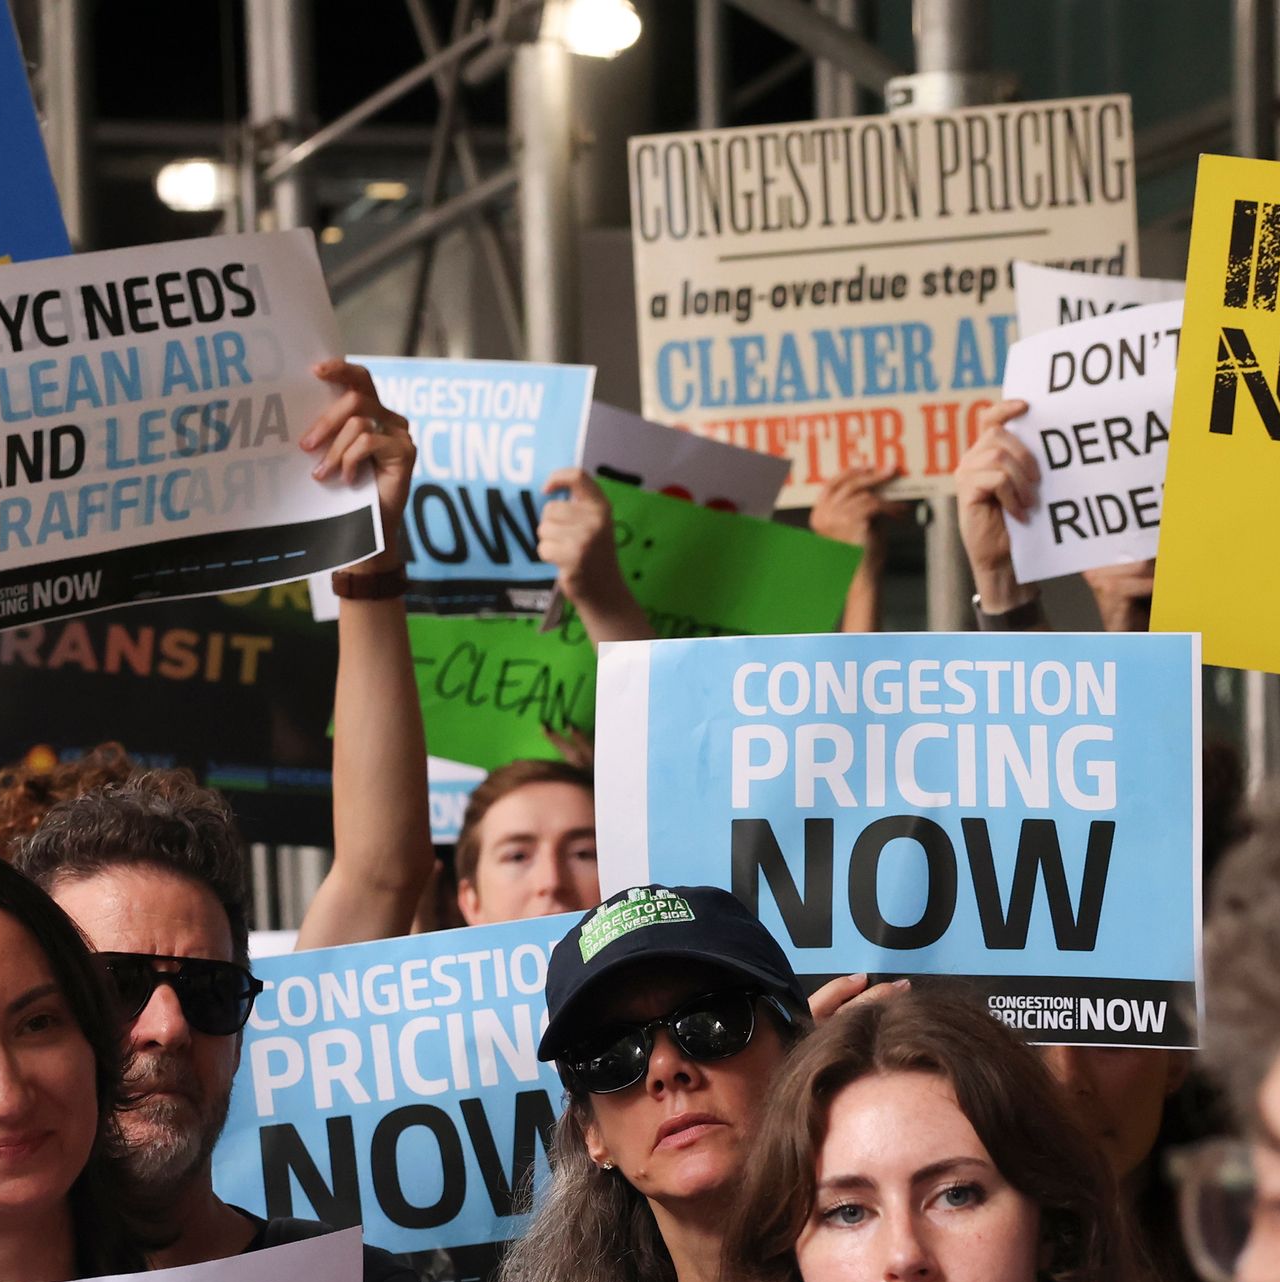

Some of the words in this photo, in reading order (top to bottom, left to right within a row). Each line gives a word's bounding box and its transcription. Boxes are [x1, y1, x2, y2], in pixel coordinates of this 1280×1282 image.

[636, 120, 921, 242] CONGESTION
[934, 105, 1129, 216] PRICING
[81, 263, 256, 339] NEEDS
[651, 294, 667, 318] a
[682, 266, 906, 323] long-overdue
[923, 263, 998, 302] step
[163, 331, 252, 395] AIR
[656, 320, 938, 412] CLEANER
[951, 314, 1017, 389] AI
[377, 377, 544, 420] NGESTION
[107, 401, 233, 468] LESS
[1041, 410, 1170, 470] DERA
[1048, 485, 1164, 544] RIDE
[33, 571, 102, 609] NOW
[730, 658, 1117, 718] CONGESTION
[730, 723, 1118, 812] PRICING
[731, 815, 1115, 952] NOW
[585, 900, 686, 948] STREETOPIA
[587, 929, 621, 957] UPPER
[621, 914, 657, 931] WEST
[660, 909, 689, 920] SIDE
[248, 941, 558, 1031] CONGESTIO
[988, 995, 1074, 1010] CONGESTION
[1080, 998, 1167, 1033] NOW
